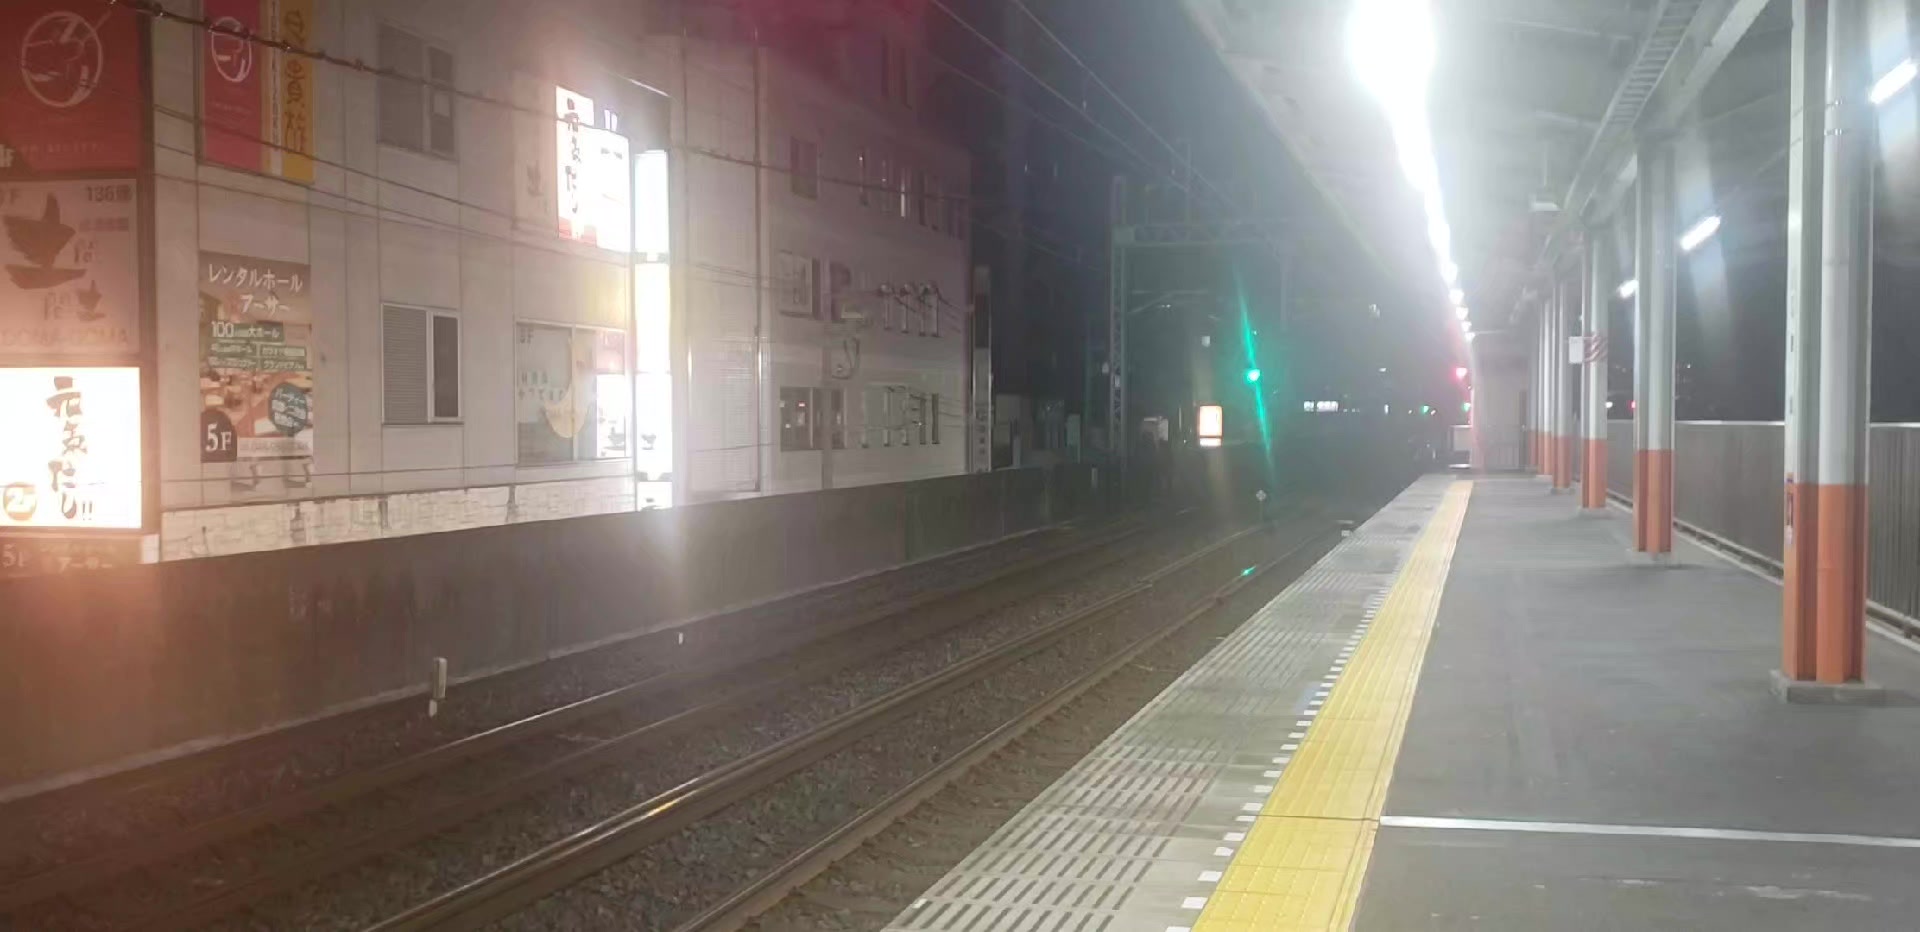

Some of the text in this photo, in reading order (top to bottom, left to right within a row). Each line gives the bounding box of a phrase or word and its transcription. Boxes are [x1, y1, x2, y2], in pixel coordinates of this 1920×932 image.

[208, 264, 304, 292] レンタルホール
[239, 294, 291, 315] アーサー
[205, 422, 232, 452] 5F
